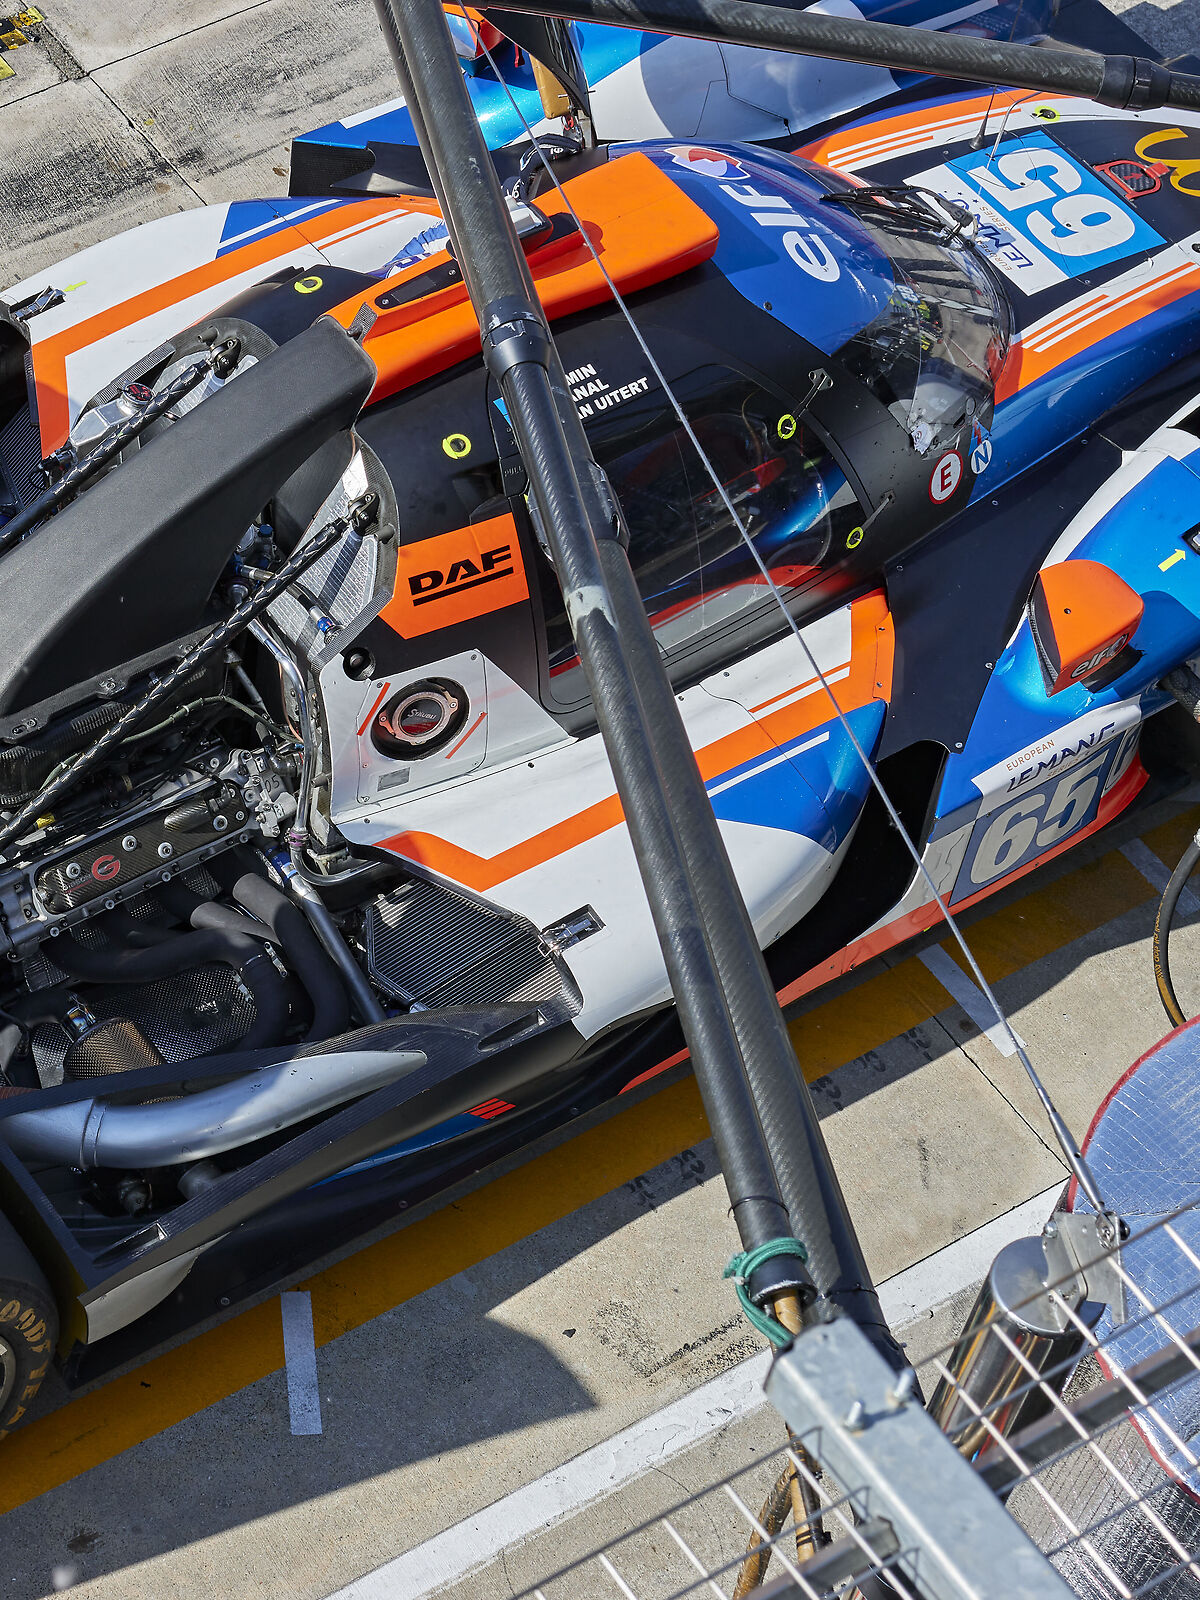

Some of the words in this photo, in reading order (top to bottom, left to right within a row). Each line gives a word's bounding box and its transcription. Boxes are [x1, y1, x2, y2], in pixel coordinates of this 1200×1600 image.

[967, 147, 1136, 257] 65
[718, 184, 841, 283] elf
[593, 376, 650, 410] UITERT
[940, 461, 952, 493] E
[974, 441, 990, 473] N
[408, 544, 512, 596] DAF
[1006, 738, 1056, 772] EUROPEAN
[970, 748, 1110, 884] 65
